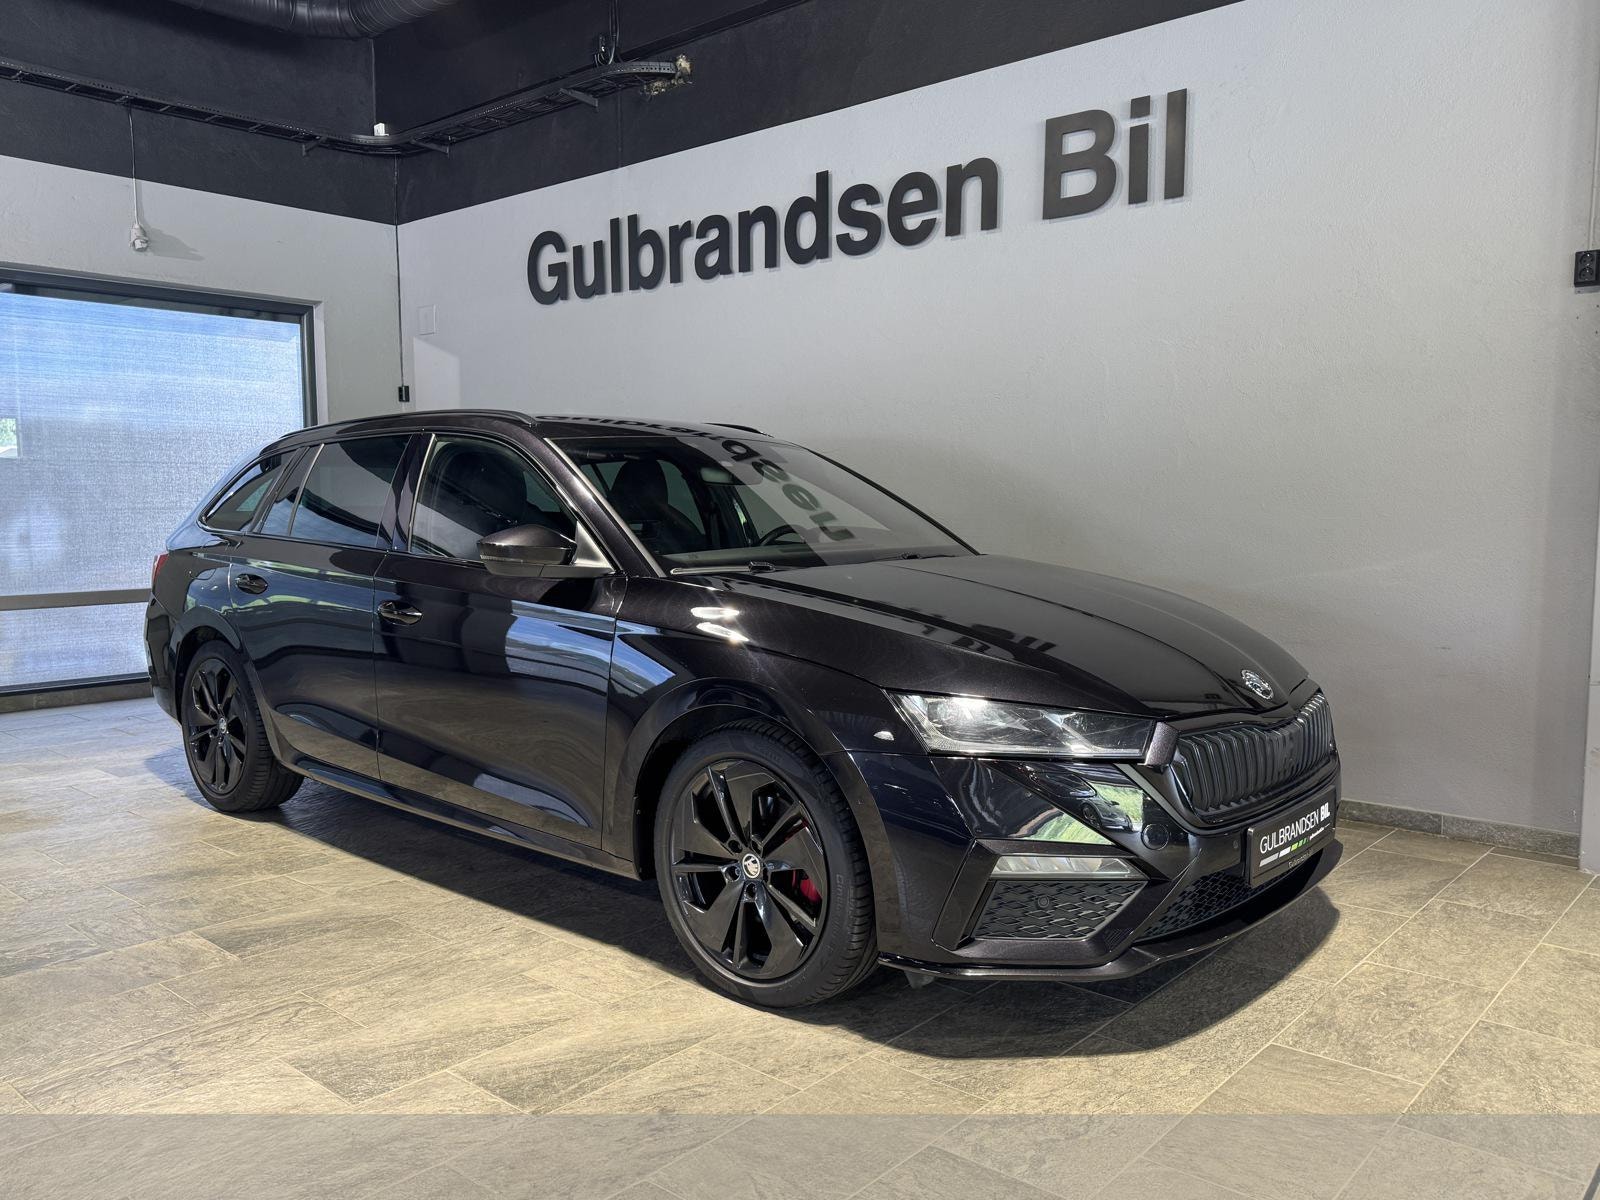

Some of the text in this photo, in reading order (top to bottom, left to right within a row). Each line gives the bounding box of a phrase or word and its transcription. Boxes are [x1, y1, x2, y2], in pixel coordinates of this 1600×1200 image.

[527, 88, 1188, 304] Gulbrandsen Bil
[1260, 809, 1319, 854] GULBRANDSEN
[1320, 802, 1331, 822] BIL
